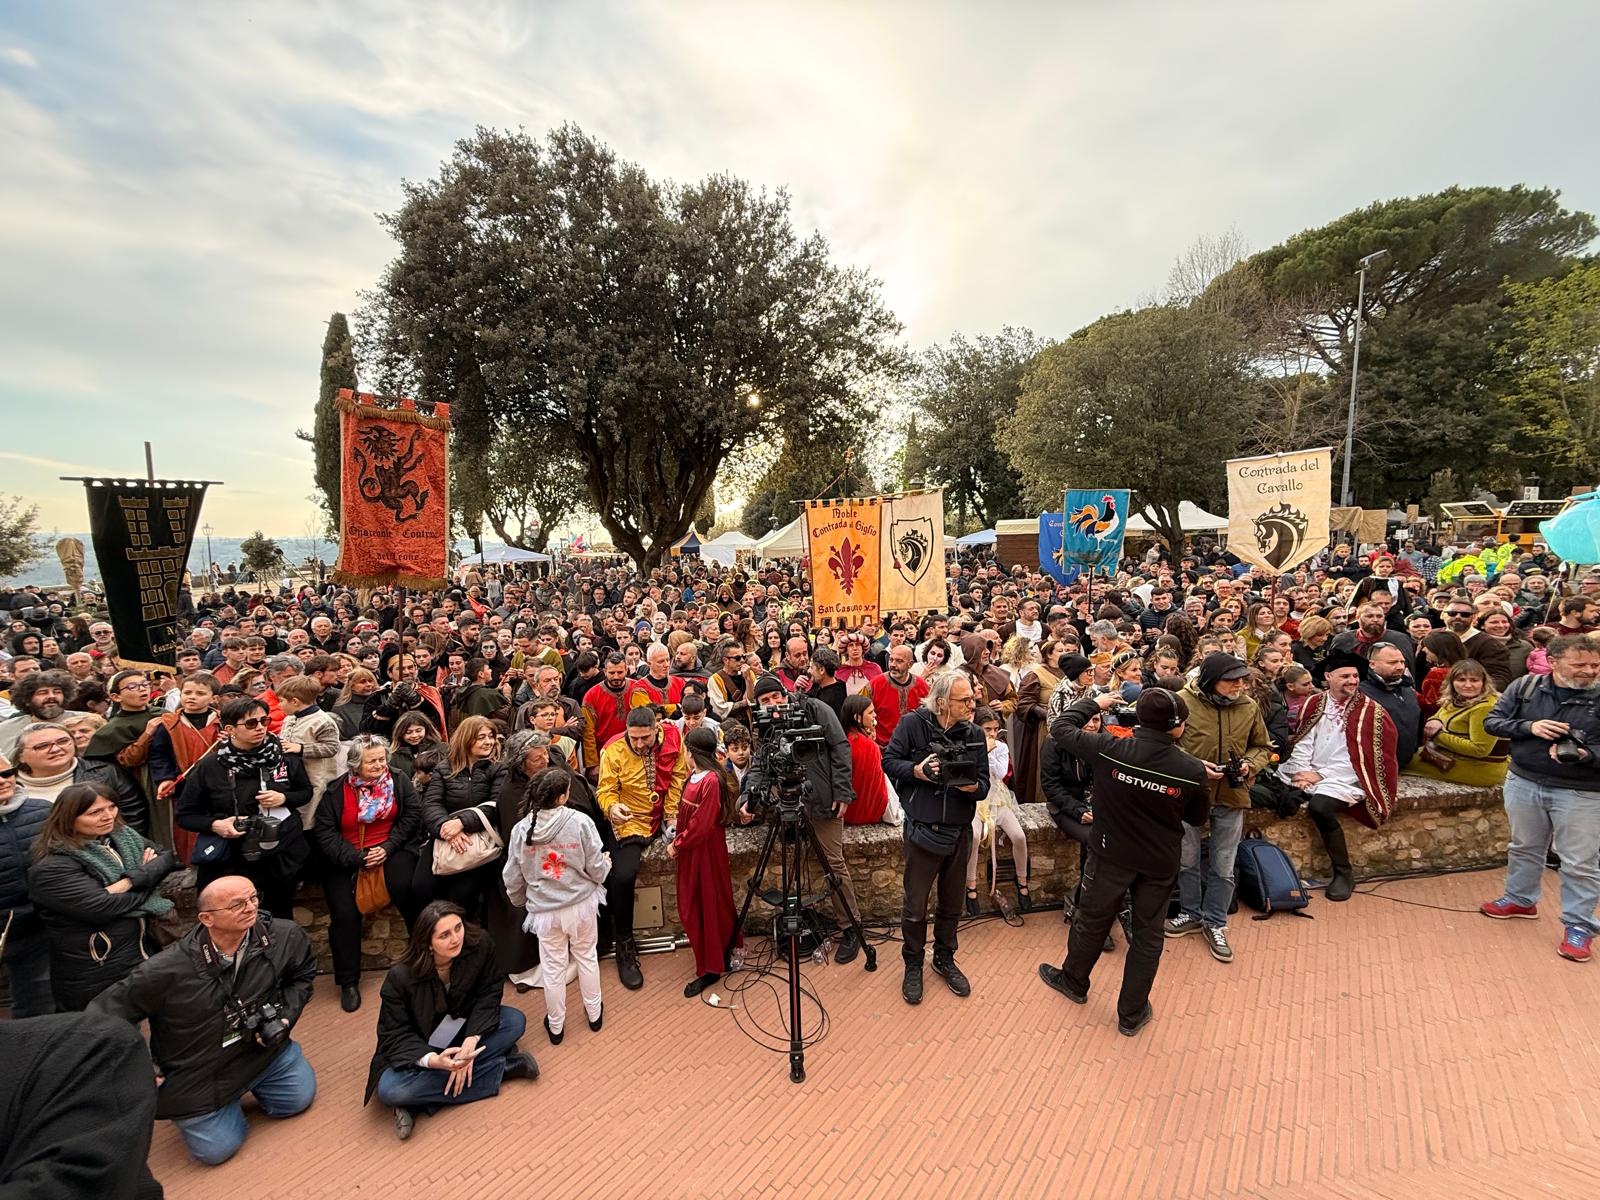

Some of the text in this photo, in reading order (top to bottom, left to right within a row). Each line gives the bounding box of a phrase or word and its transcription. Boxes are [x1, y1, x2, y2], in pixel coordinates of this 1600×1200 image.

[1239, 458, 1320, 478] Contrada del
[1257, 479, 1304, 494] Cavallo
[812, 519, 848, 538] Contrada
[855, 520, 877, 536] Giglio
[817, 604, 835, 614] San
